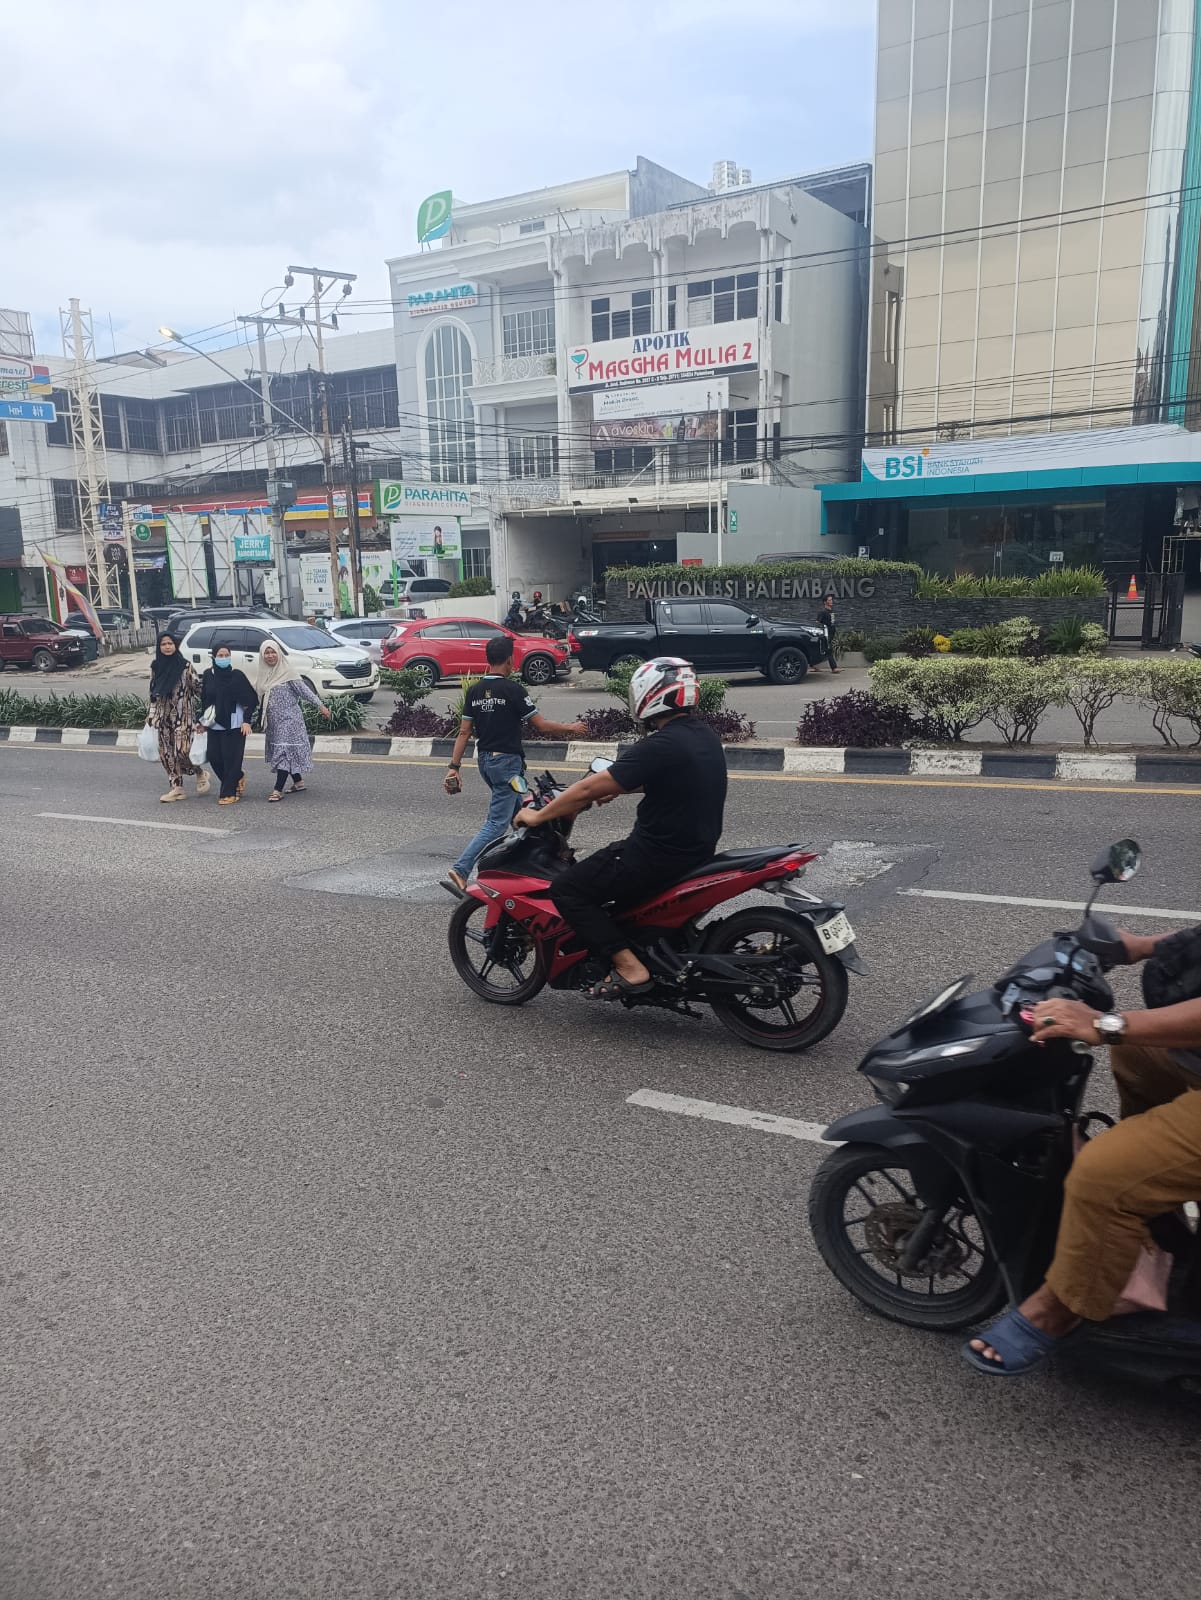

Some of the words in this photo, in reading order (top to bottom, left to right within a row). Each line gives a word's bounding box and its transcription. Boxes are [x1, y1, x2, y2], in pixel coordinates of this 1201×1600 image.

[408, 284, 475, 307] PARAHITA
[632, 331, 690, 354] APOTIK
[589, 353, 669, 381] MAGGHA
[675, 344, 737, 369] MULIA
[742, 342, 752, 360] 2
[611, 422, 654, 437] avoskin
[885, 455, 923, 479] BSI
[927, 466, 969, 476] INDONESIA
[404, 488, 468, 502] PARAHITA
[240, 539, 265, 549] JERRY
[626, 579, 706, 599] PAVILION
[713, 579, 739, 598] BSI
[746, 577, 875, 599] PALEMBANG
